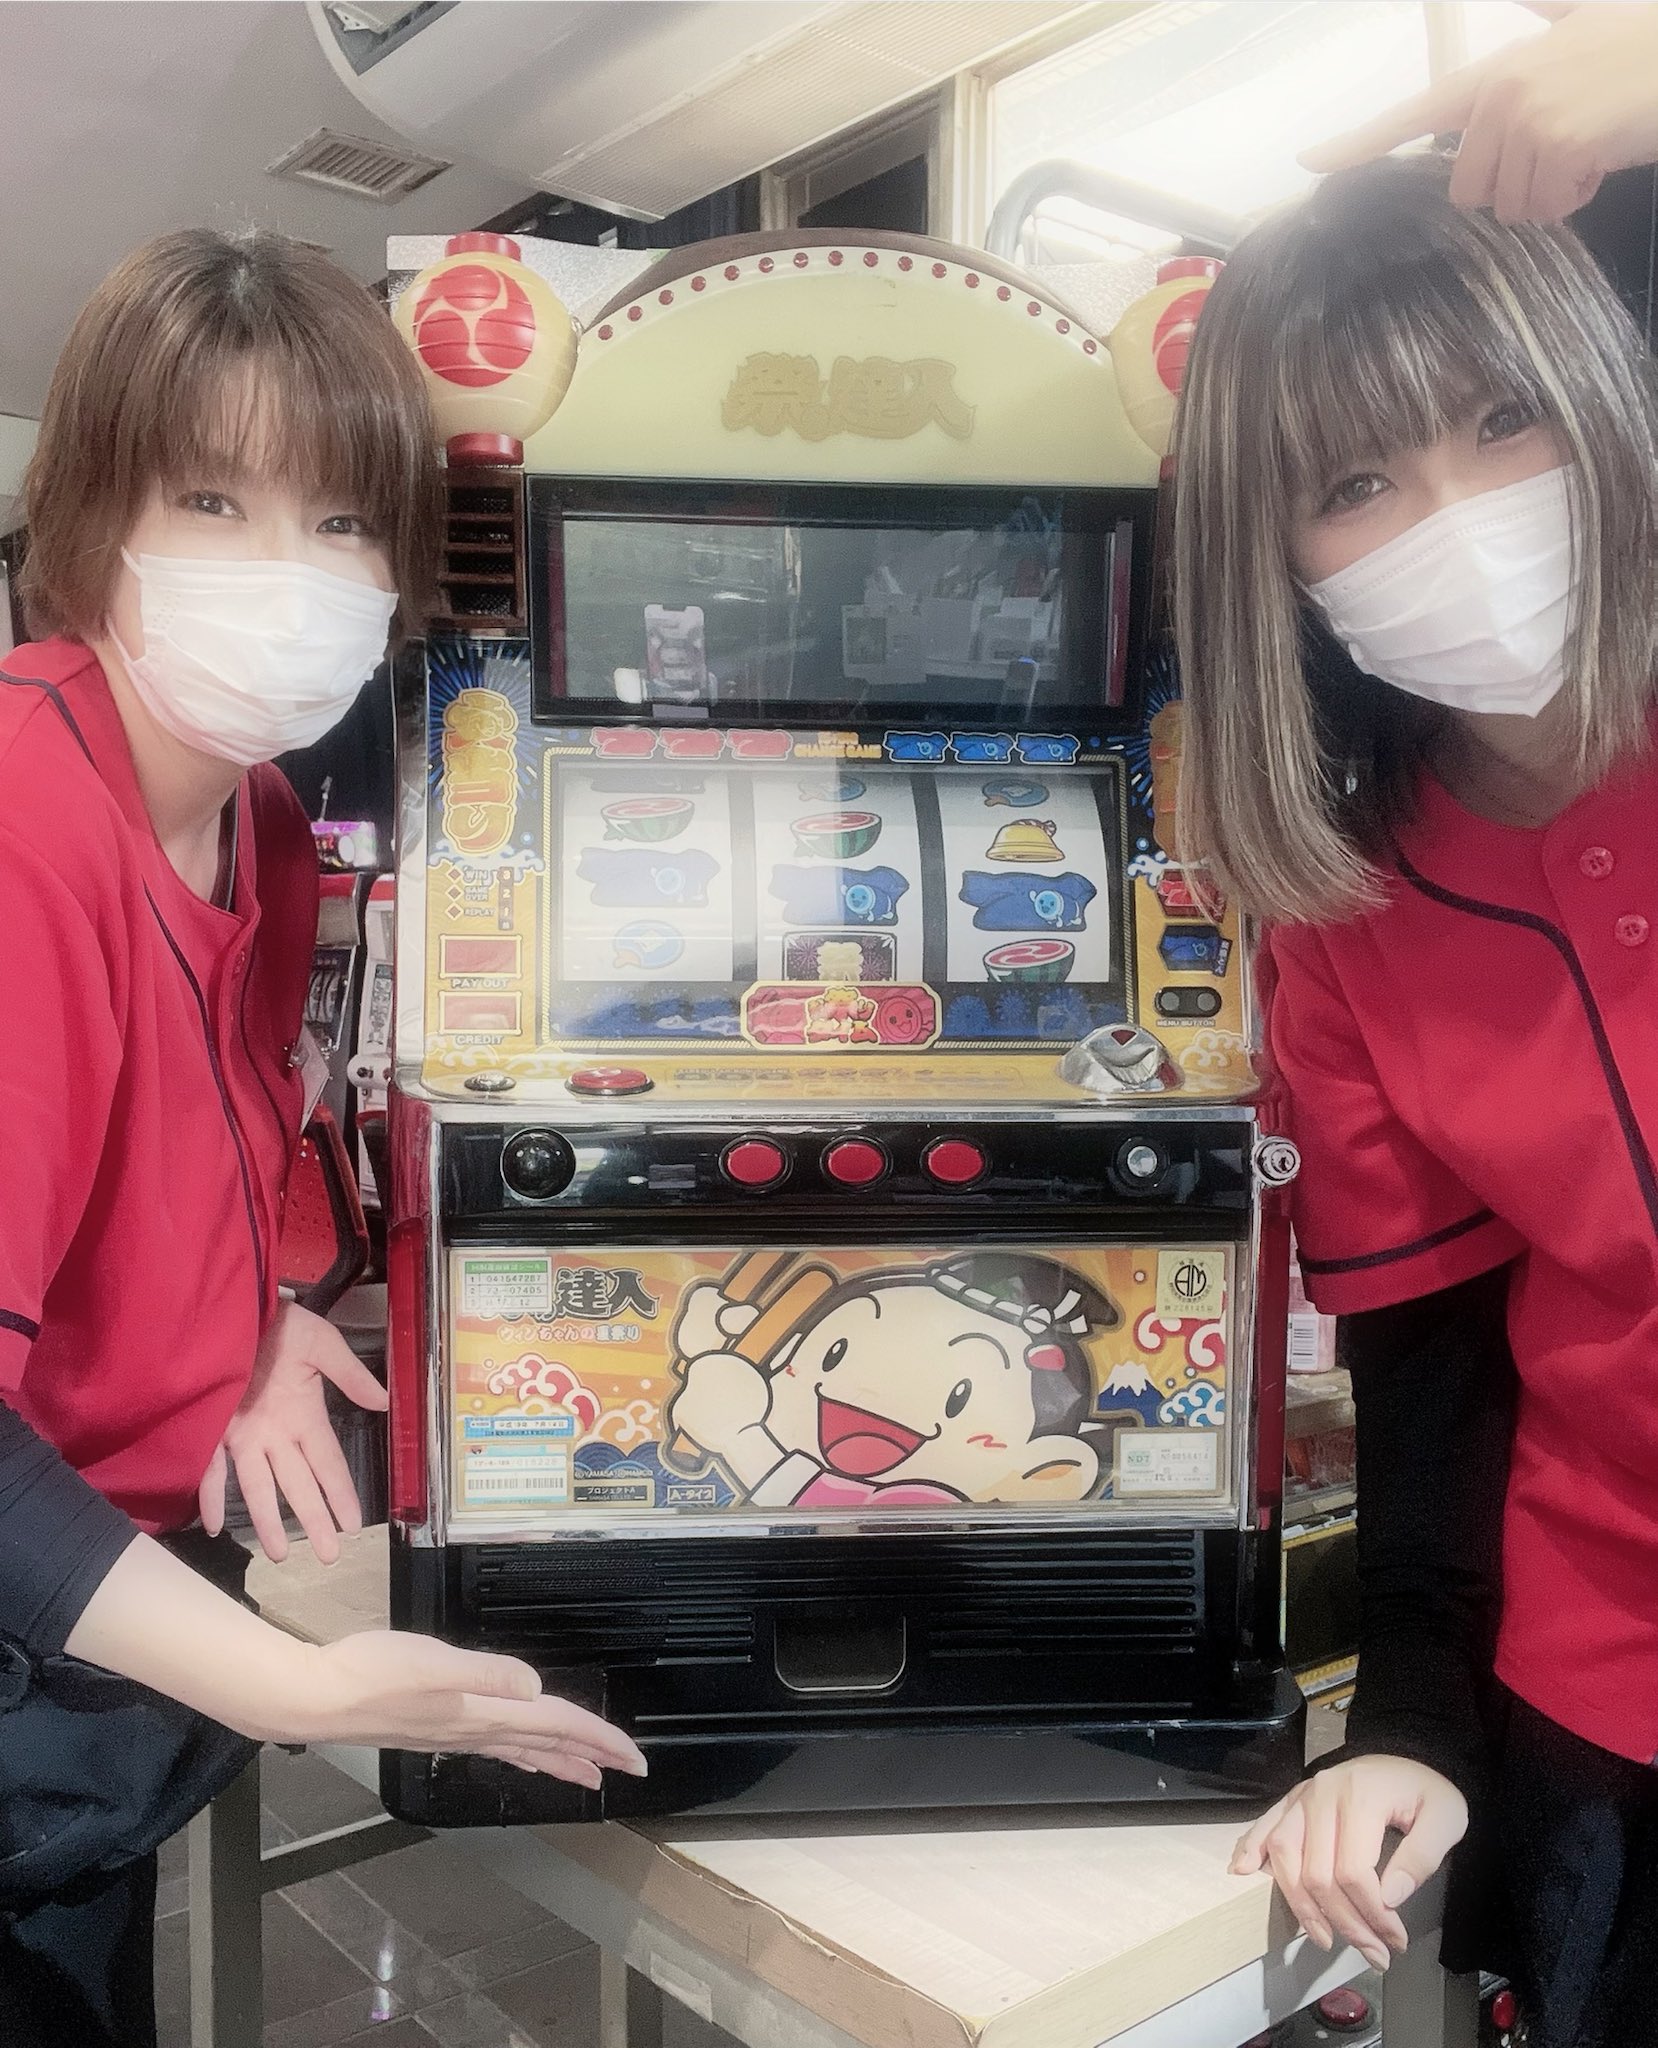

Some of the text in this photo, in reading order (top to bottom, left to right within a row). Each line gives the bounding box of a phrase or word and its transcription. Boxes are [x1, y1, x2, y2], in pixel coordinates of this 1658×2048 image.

[465, 908, 495, 916] REPLAY
[452, 978, 508, 988] PAY OUT
[456, 1035, 503, 1045] CREDIT
